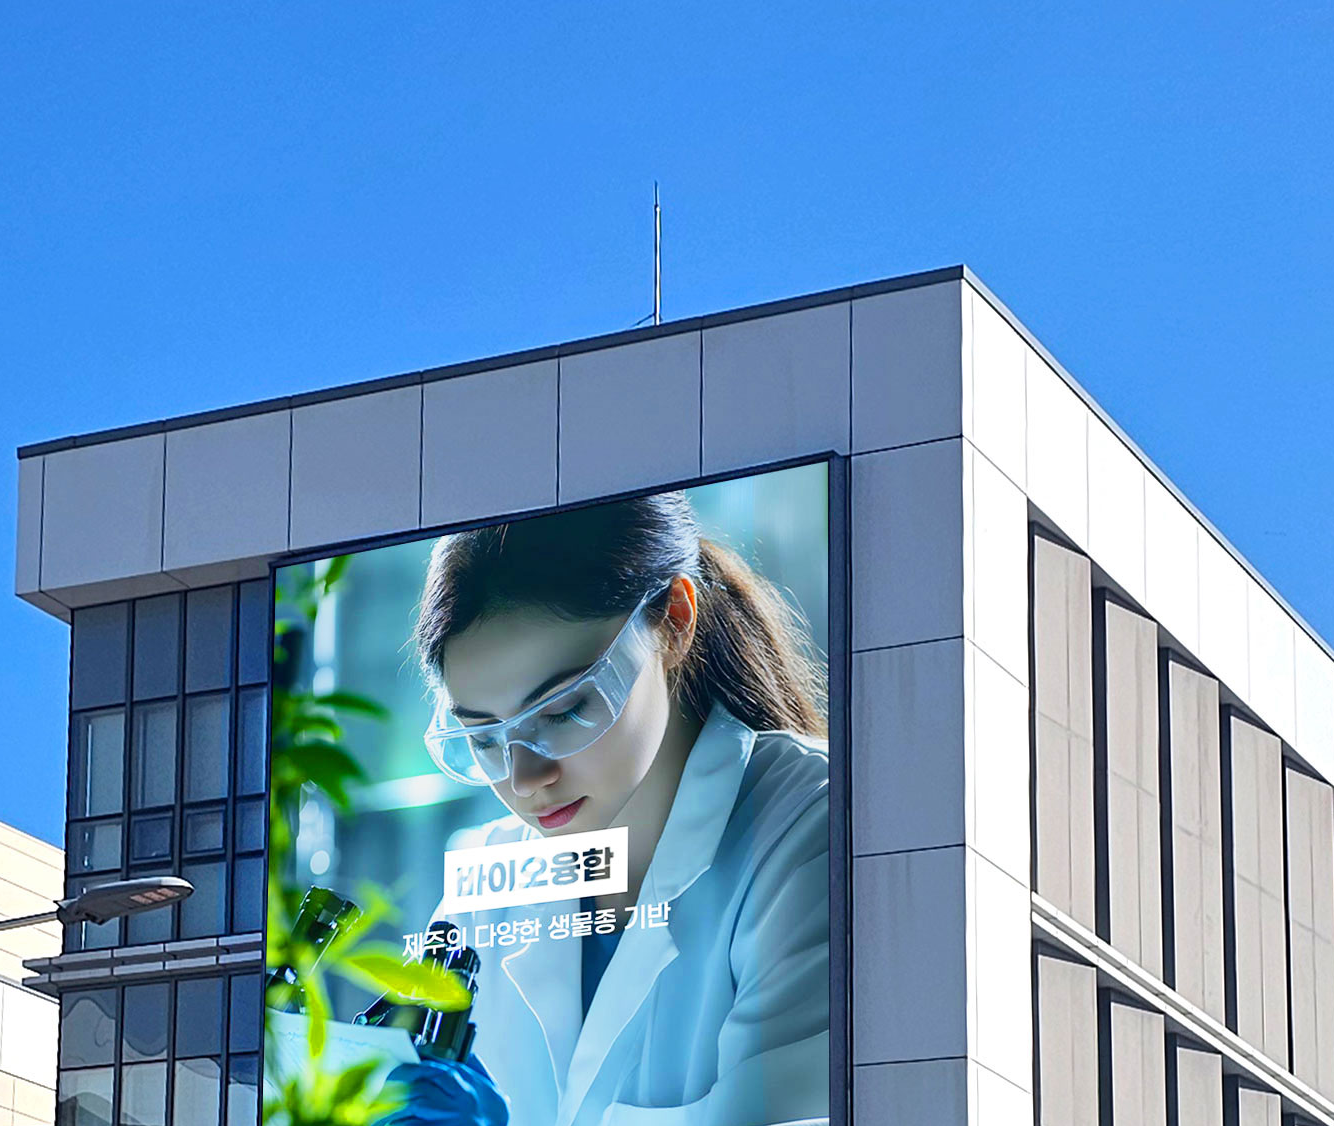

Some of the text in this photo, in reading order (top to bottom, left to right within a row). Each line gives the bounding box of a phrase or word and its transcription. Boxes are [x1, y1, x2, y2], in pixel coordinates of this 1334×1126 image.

[457, 847, 614, 897] 바이오융합
[402, 900, 671, 960] 제주의 다양한 생물종 기반
